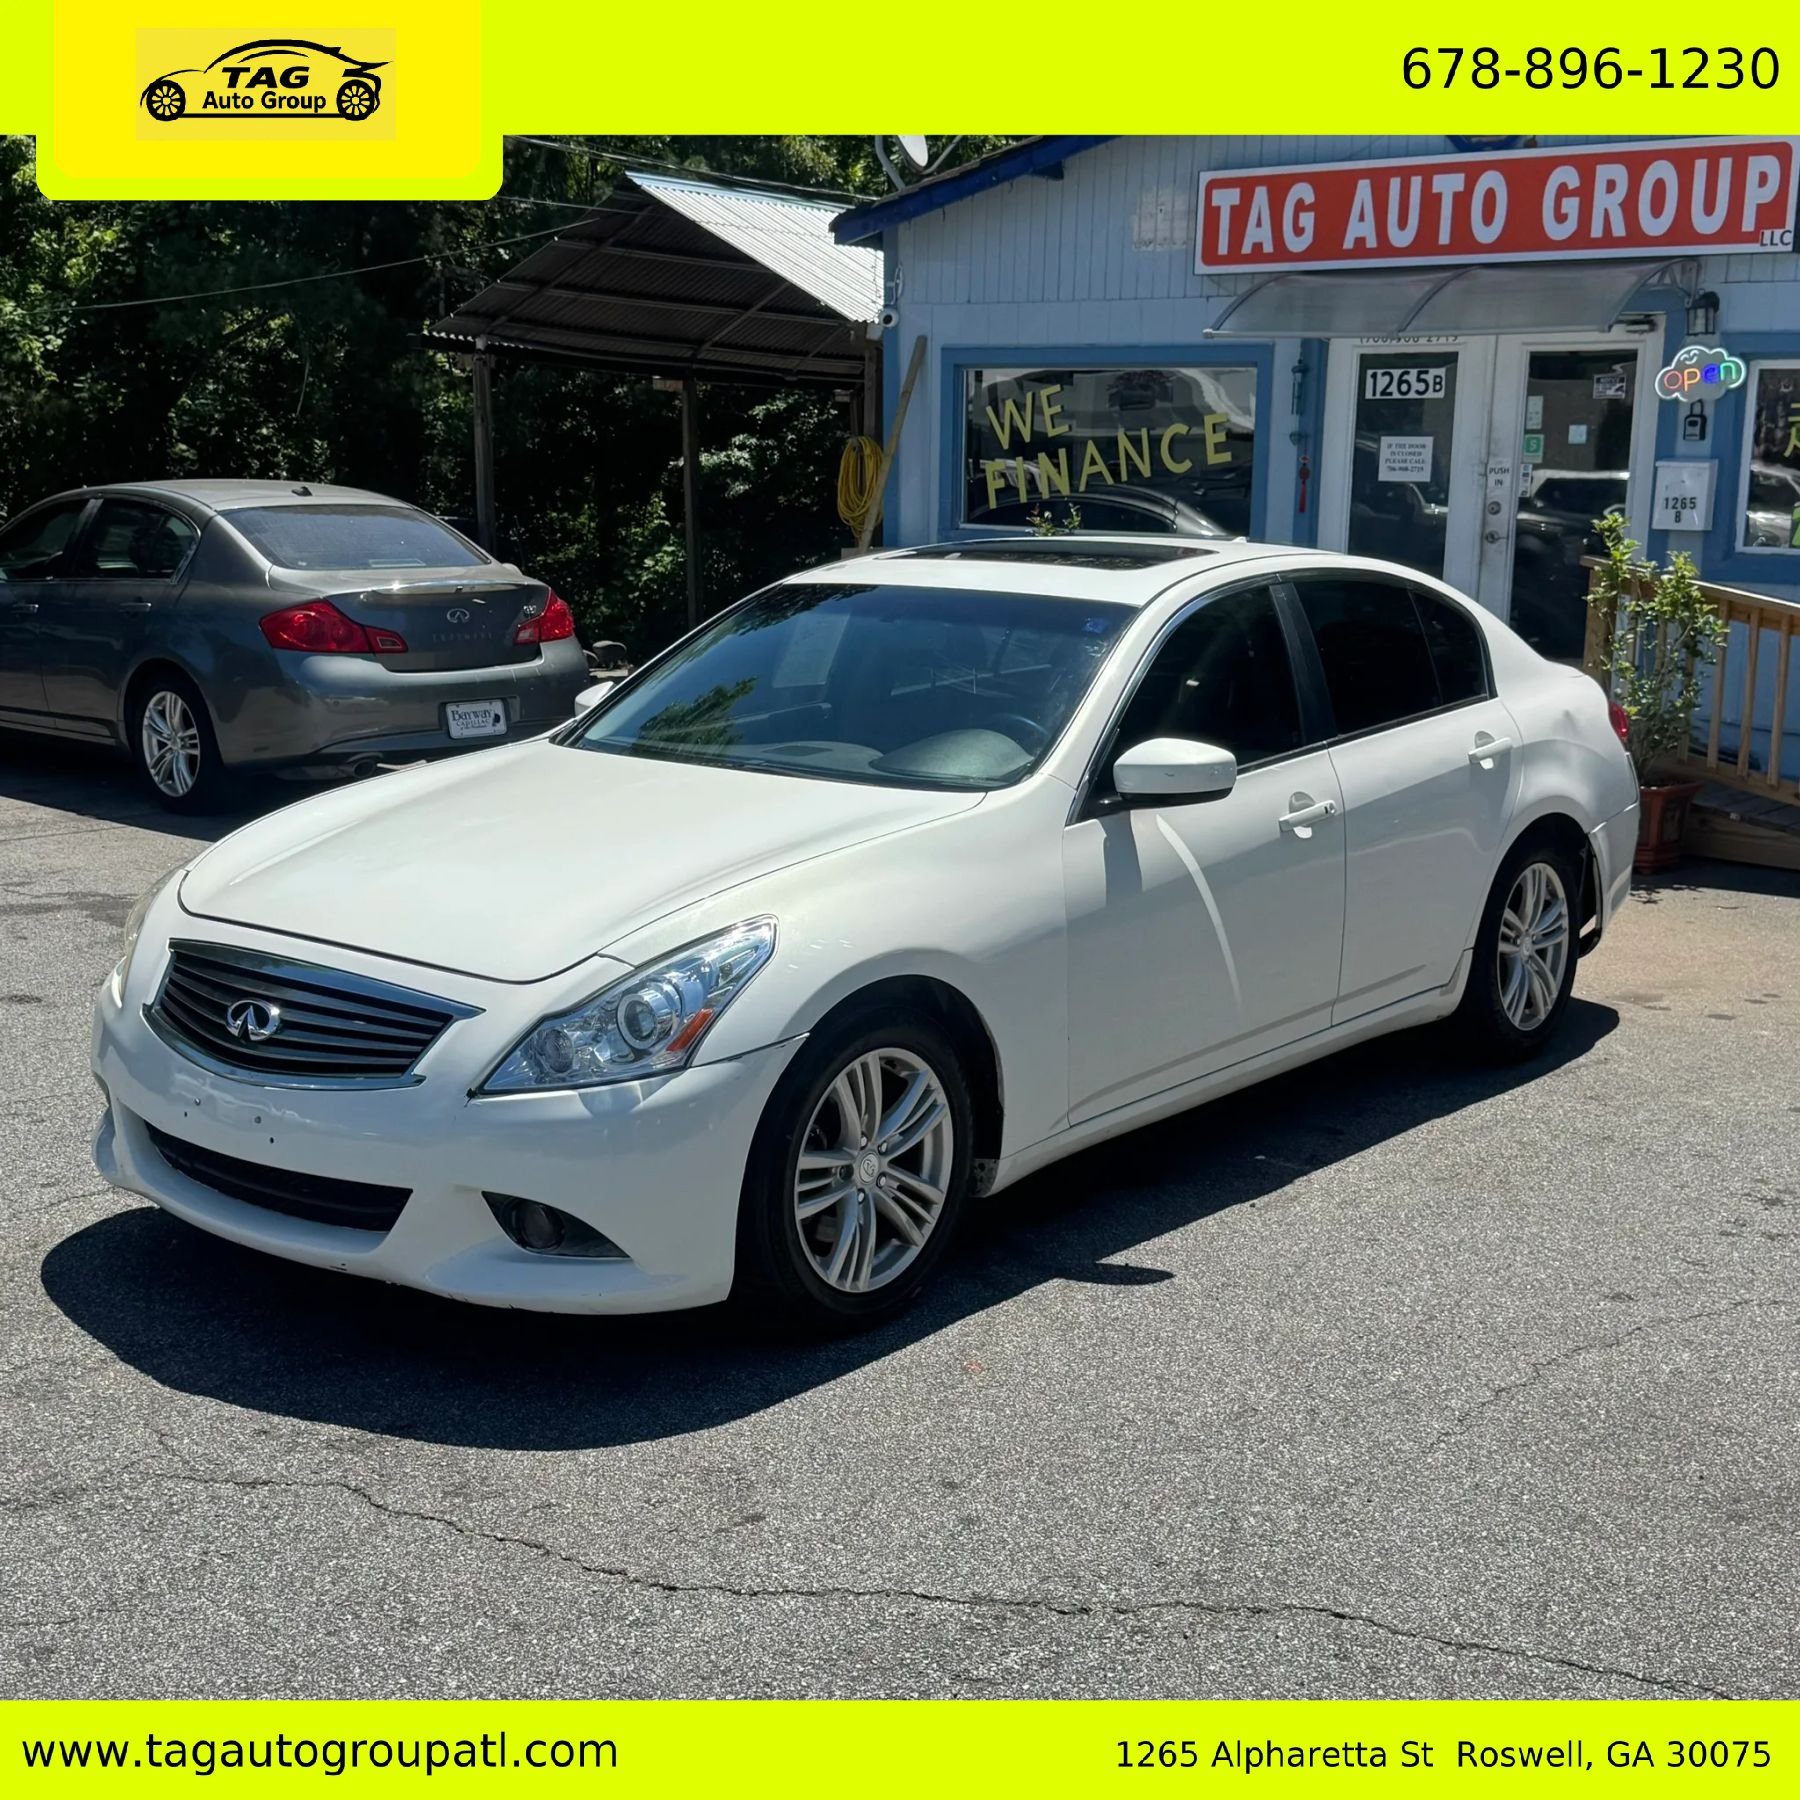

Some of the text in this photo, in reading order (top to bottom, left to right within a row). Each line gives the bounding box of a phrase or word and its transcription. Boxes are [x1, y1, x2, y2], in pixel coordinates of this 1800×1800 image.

[1211, 154, 1781, 256] TAG AUTO GROUP
[1759, 230, 1793, 248] LLC
[1663, 361, 1737, 392] open
[985, 384, 1071, 450] WE
[984, 412, 1233, 510] FINANCE
[1489, 467, 1510, 475] PUSH
[1664, 497, 1697, 510] 1265
[1674, 511, 1682, 523] B
